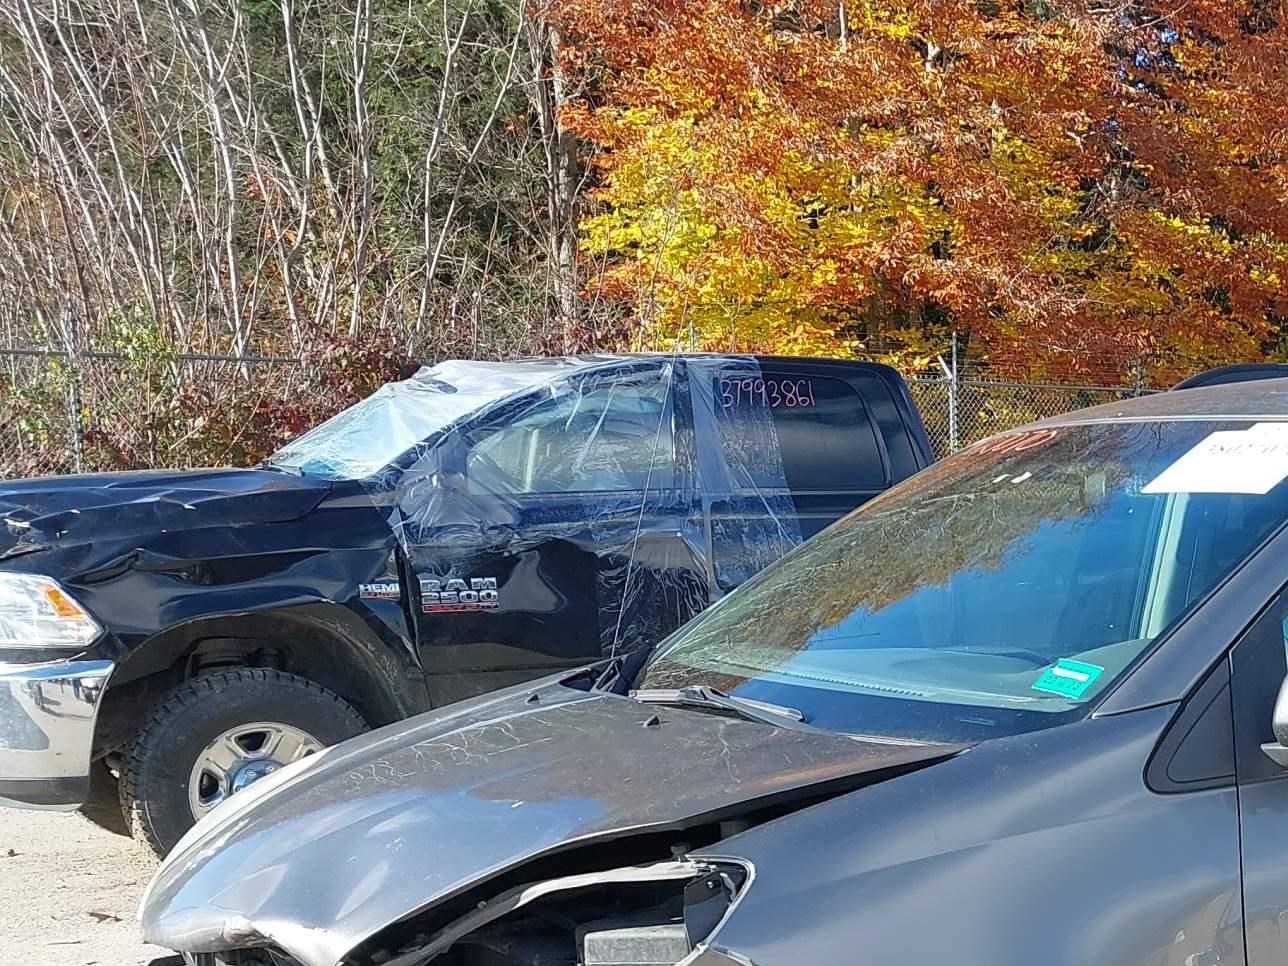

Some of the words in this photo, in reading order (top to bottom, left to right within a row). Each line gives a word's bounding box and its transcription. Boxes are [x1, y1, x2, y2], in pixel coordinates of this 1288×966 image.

[720, 379, 816, 408] 37993861
[358, 583, 400, 592] HEMI
[420, 577, 498, 592] RAM
[421, 589, 499, 604] 2500
